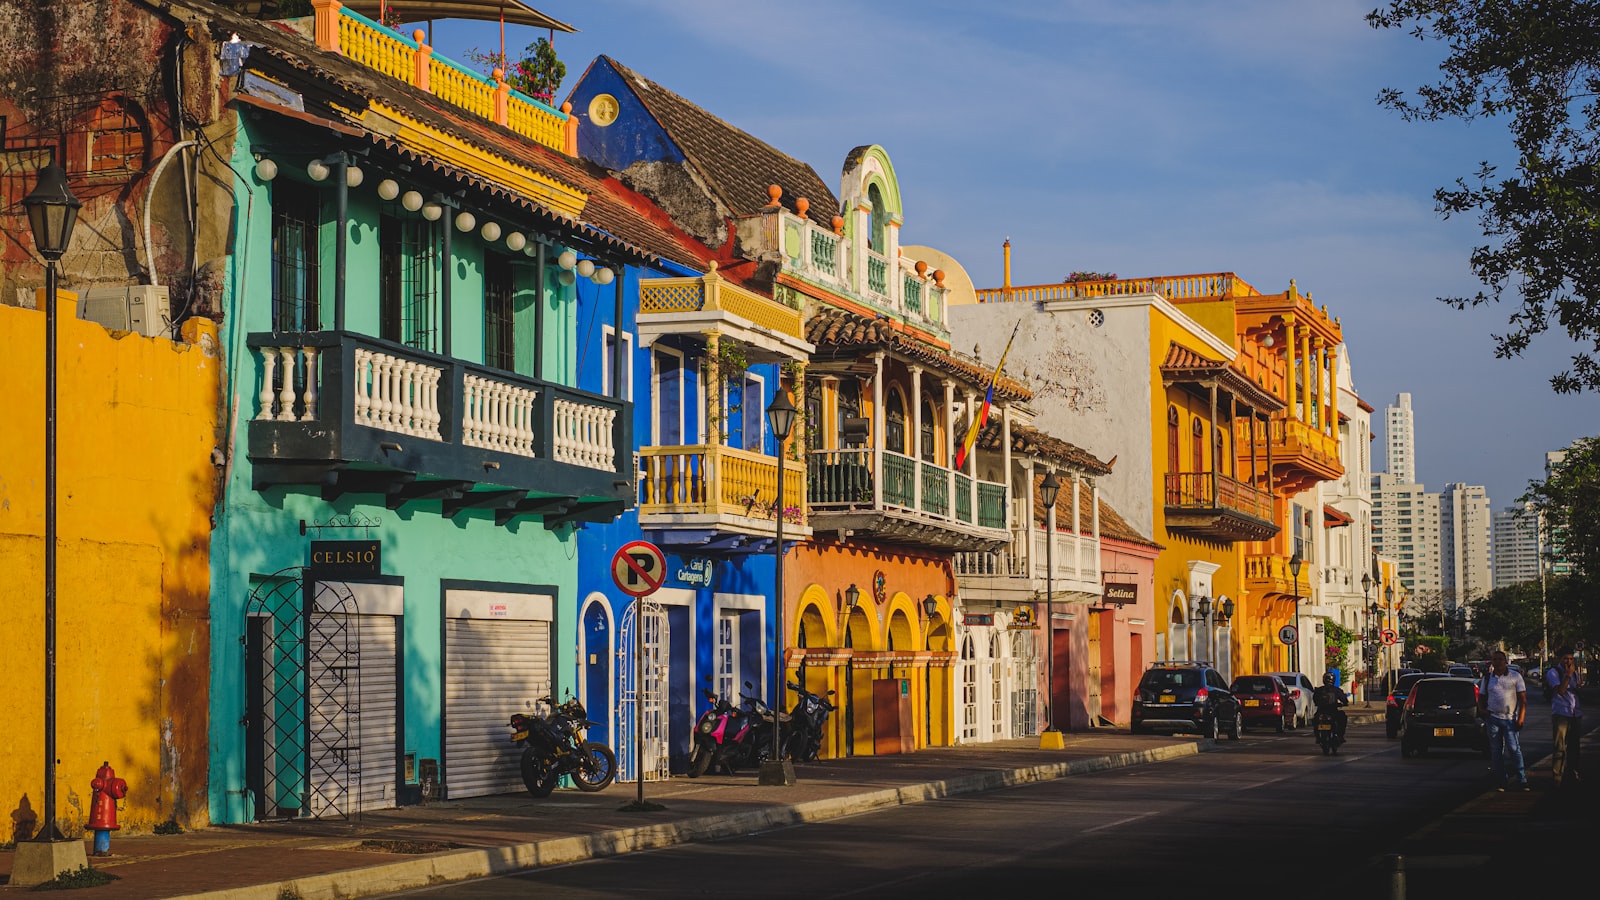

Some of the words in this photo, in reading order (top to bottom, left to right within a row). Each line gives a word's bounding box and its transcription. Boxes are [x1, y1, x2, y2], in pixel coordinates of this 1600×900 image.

[628, 554, 654, 585] P
[690, 560, 703, 571] Canal
[678, 569, 703, 584] Cartagena
[1107, 588, 1134, 598] Selina
